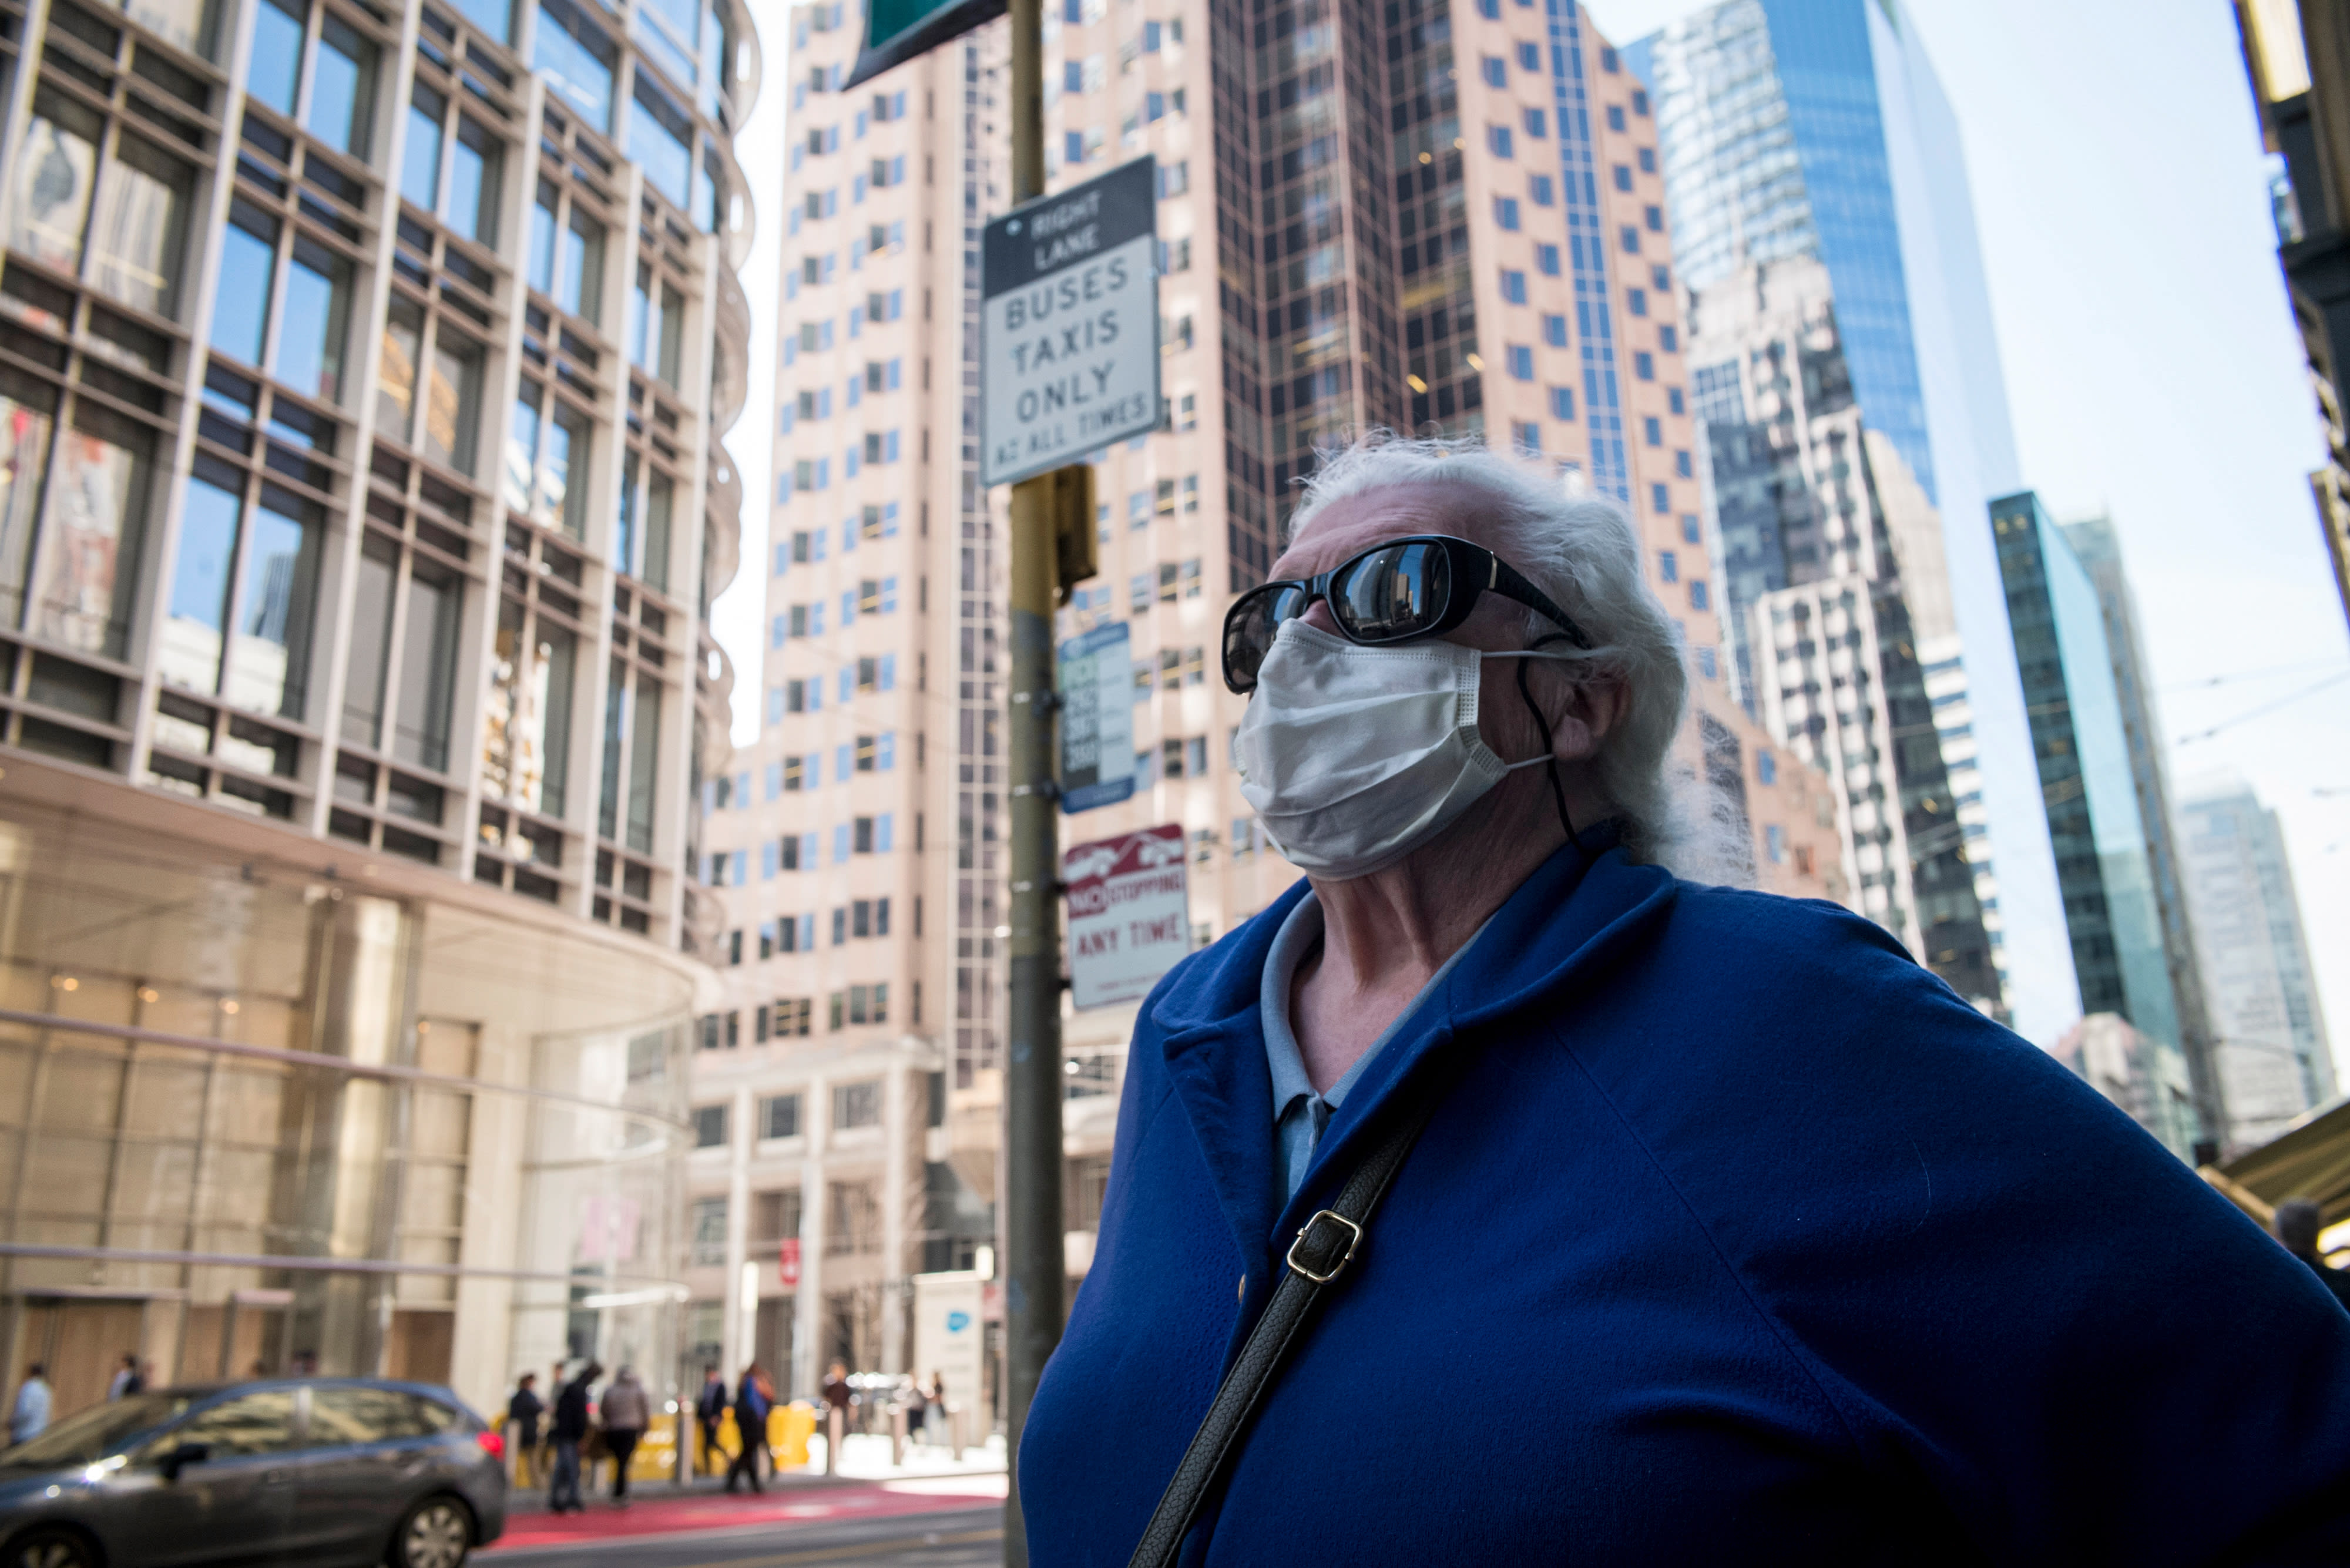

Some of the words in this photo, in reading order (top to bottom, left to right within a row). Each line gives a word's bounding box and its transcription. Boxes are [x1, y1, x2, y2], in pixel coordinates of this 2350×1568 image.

[1030, 191, 1100, 237] RIGHT
[1035, 224, 1099, 270] LANE
[1005, 257, 1127, 330] BUSES
[1015, 310, 1119, 374] TAXIS
[1016, 361, 1114, 423] ONLY
[1028, 425, 1067, 453] ALL
[1079, 392, 1146, 437] TIMES
[1069, 885, 1106, 911] NO
[1077, 926, 1119, 956] ANY
[1130, 914, 1180, 947] TIME
